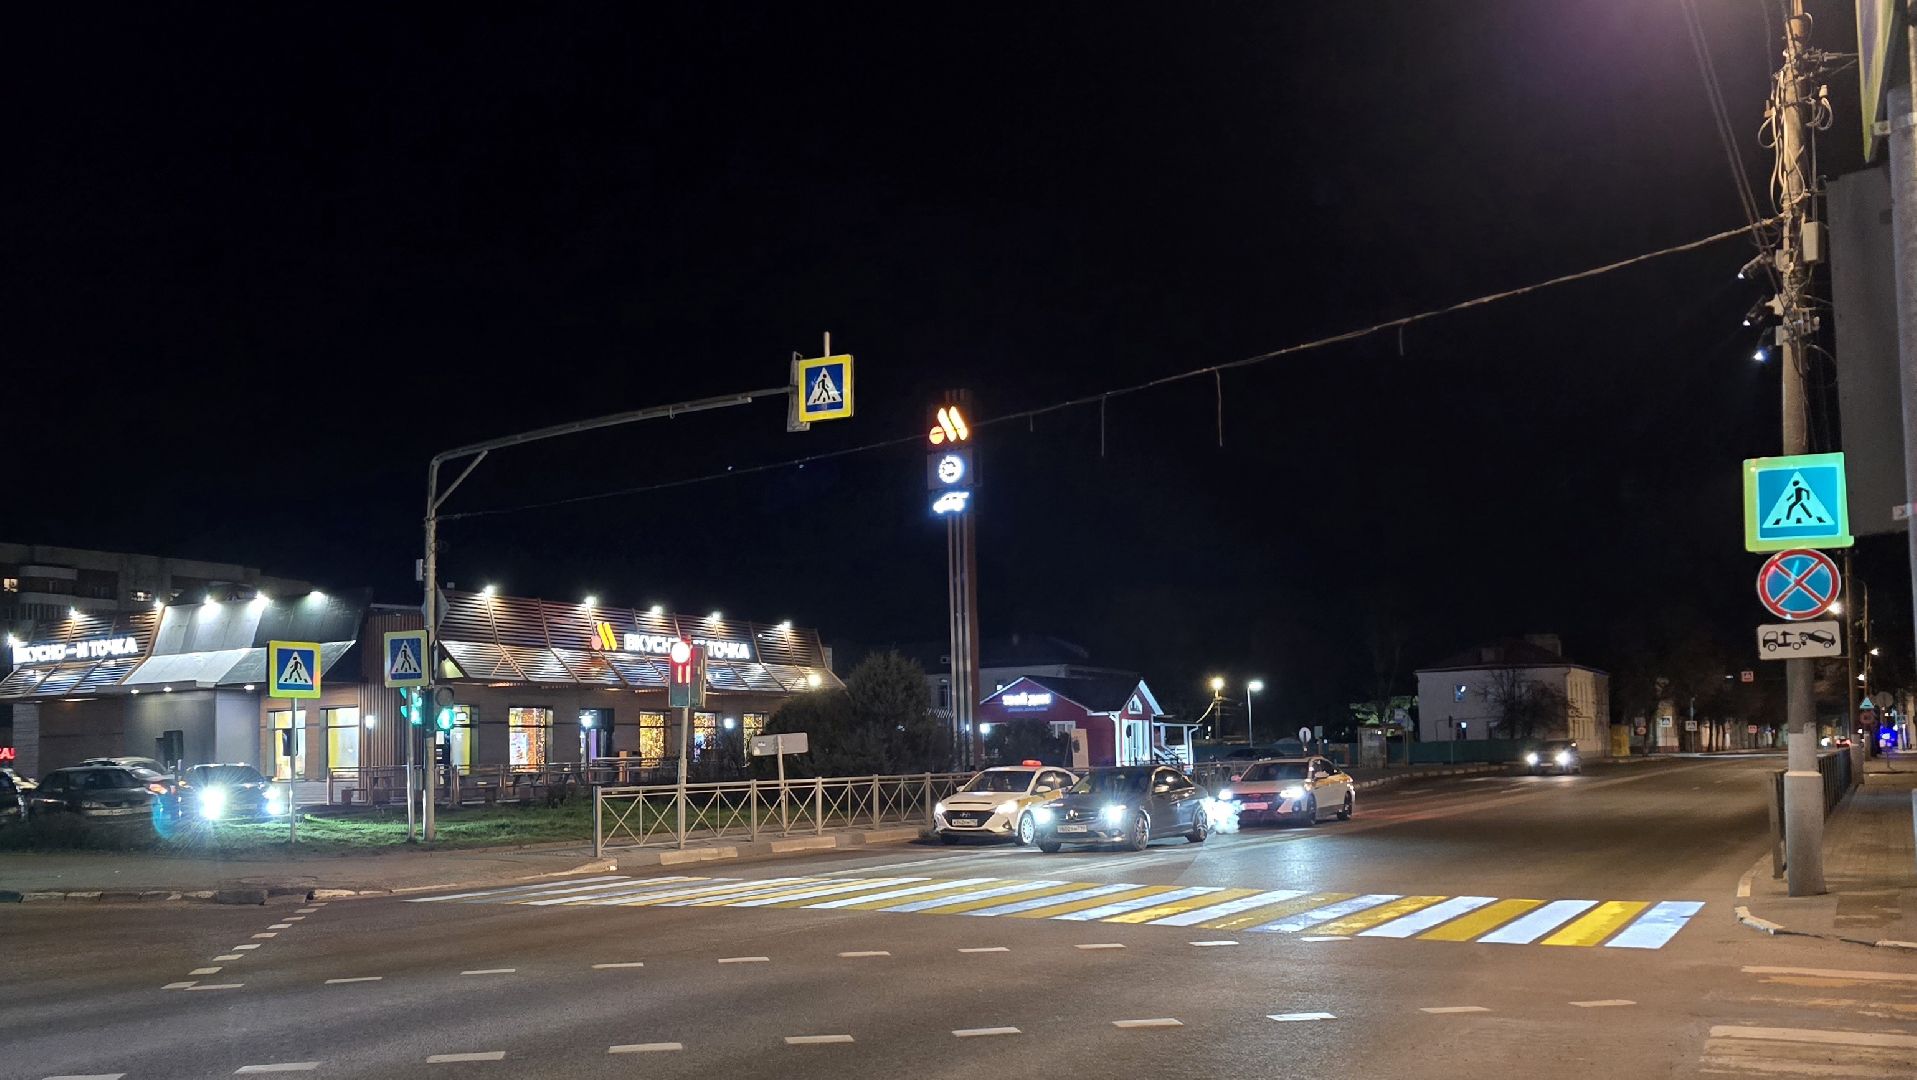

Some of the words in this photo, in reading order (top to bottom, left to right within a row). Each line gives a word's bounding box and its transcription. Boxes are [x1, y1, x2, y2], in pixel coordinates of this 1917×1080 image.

[89, 637, 139, 657] ТОЧКА
[624, 634, 681, 652] ВКУСН
[706, 640, 750, 659] ТОЧКА
